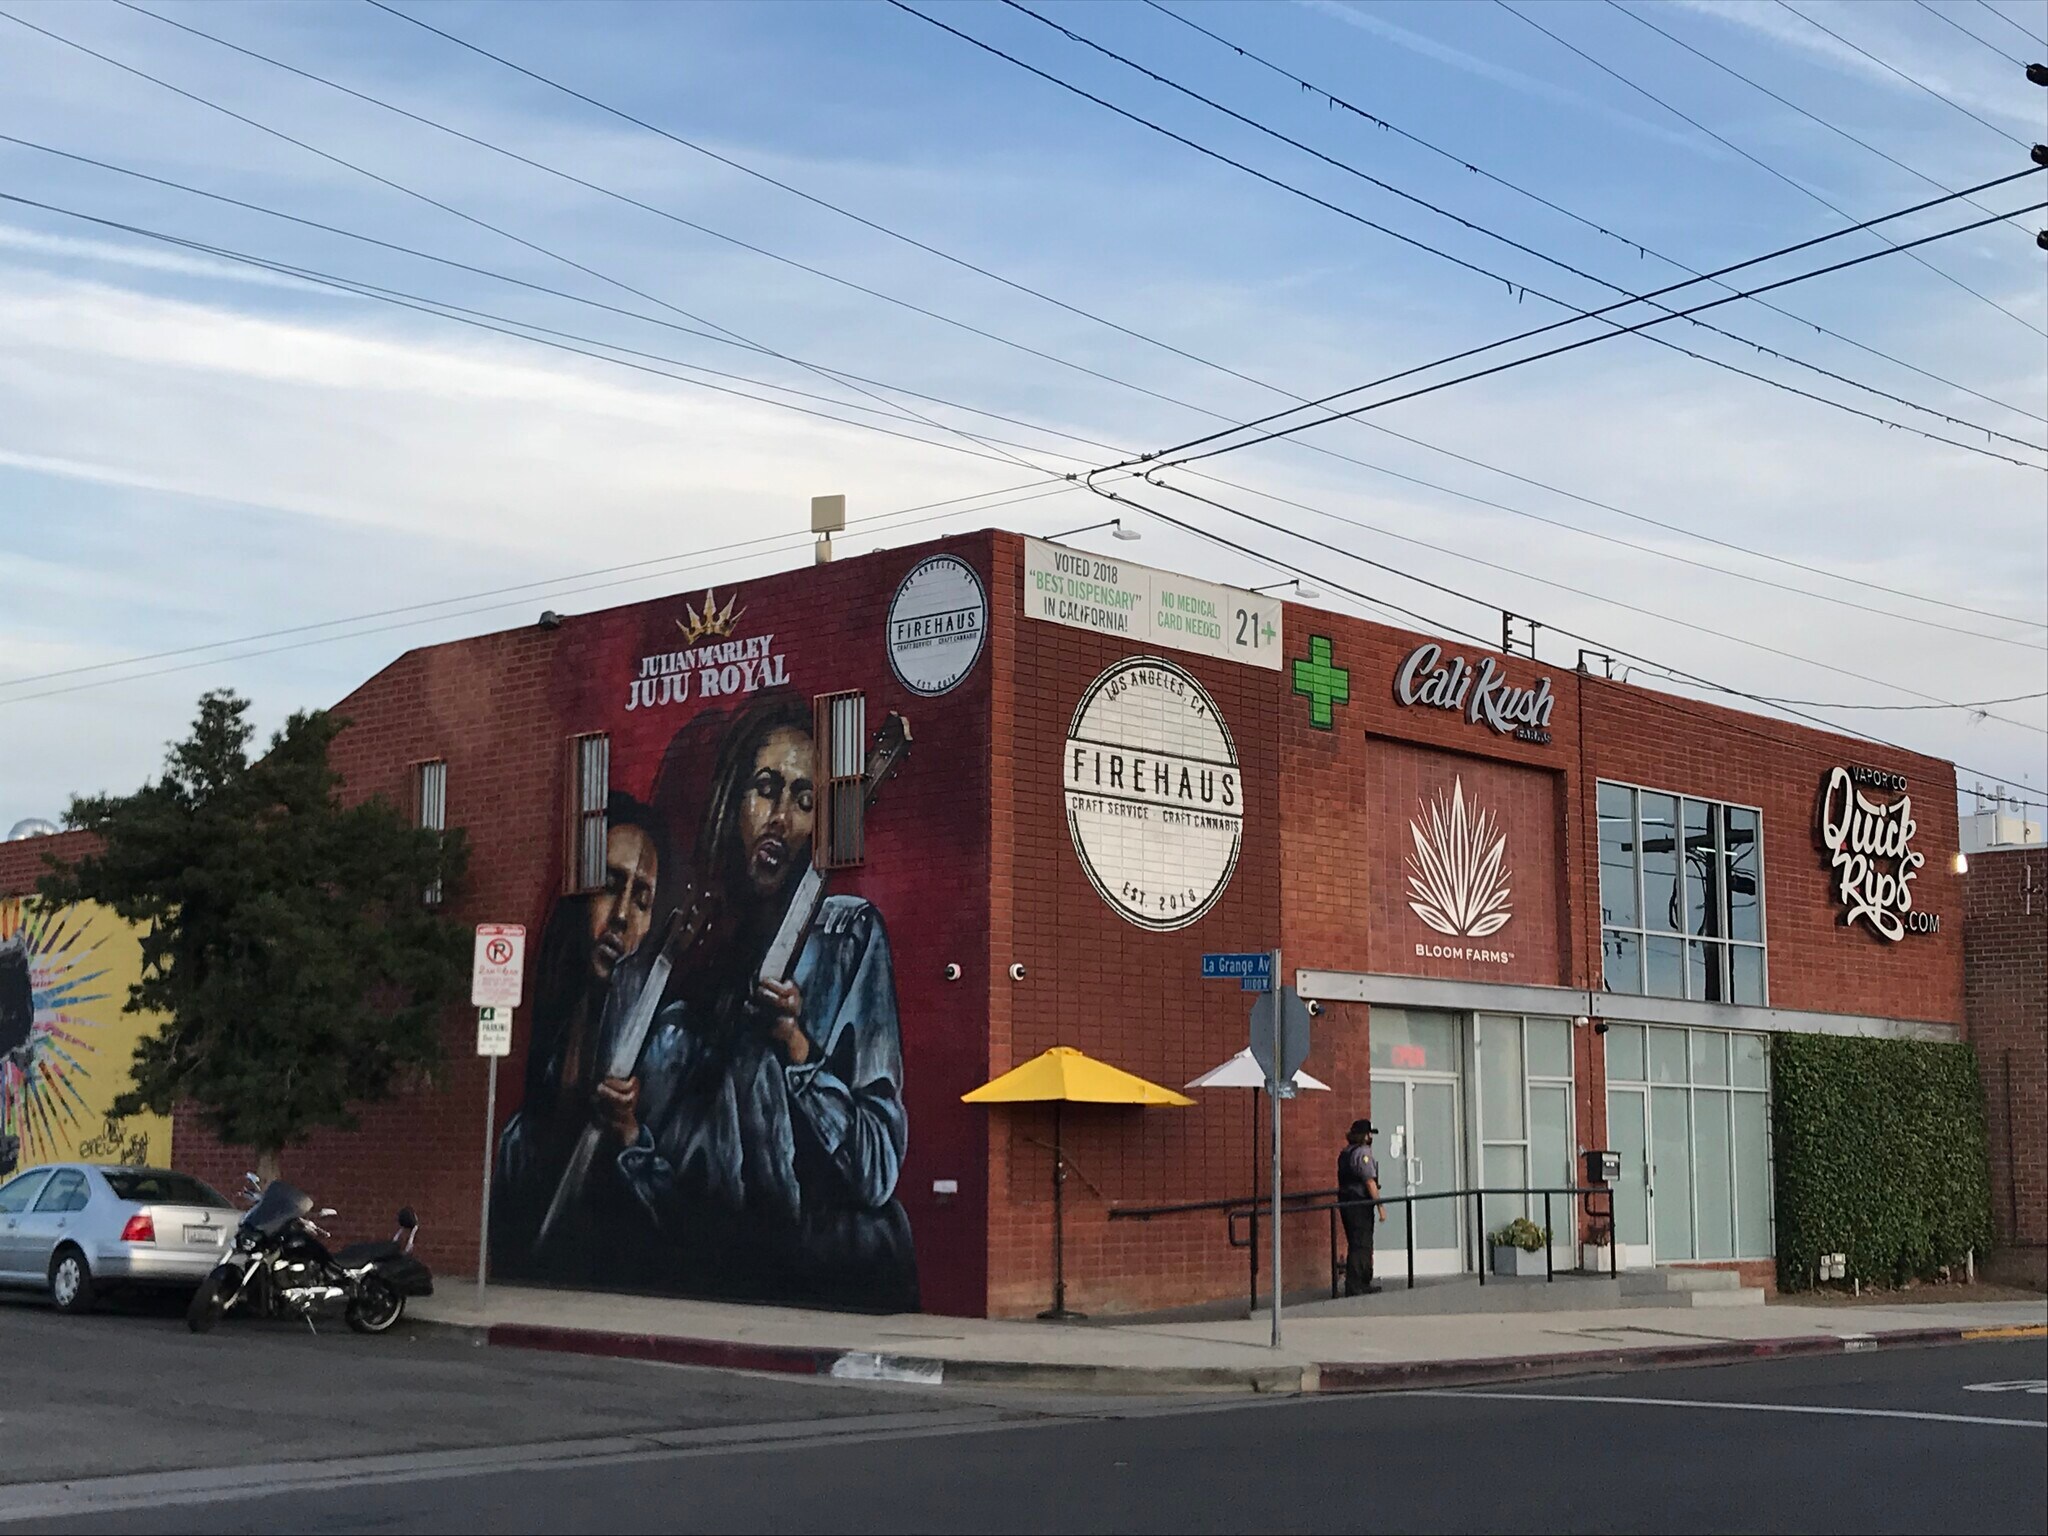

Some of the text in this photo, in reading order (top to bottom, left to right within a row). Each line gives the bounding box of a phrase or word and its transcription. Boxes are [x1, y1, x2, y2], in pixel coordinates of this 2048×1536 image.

[963, 572, 974, 585] CA
[1054, 551, 1118, 584] VOTED 2018
[1043, 596, 1128, 633] IN CALIFORNIA!
[1161, 590, 1218, 619] NO MEDICAL
[898, 611, 976, 640] FIREHAUS
[1157, 607, 1221, 640] CARD NEEDED
[638, 634, 774, 679] JULIAN MARLEY
[897, 642, 912, 652] CRAFT
[938, 635, 953, 645] CRAFT
[625, 654, 790, 711] JUJU ROYAL
[1106, 679, 1127, 702] LOS
[1190, 696, 1206, 719] CA
[1398, 643, 1555, 734] Cali Kush
[1516, 729, 1552, 743] FARMS
[1074, 748, 1235, 807] FIREHAUS
[1853, 766, 1888, 787] VAPOR
[1072, 796, 1239, 833] CRAFT SERVICE CRAFT CANNABIS
[1823, 766, 1917, 859] Quick
[1159, 889, 1197, 911] 2018
[1832, 851, 1925, 941] Rips
[1203, 957, 1270, 975] La Grange Av
[1415, 943, 1463, 960] BLOOM
